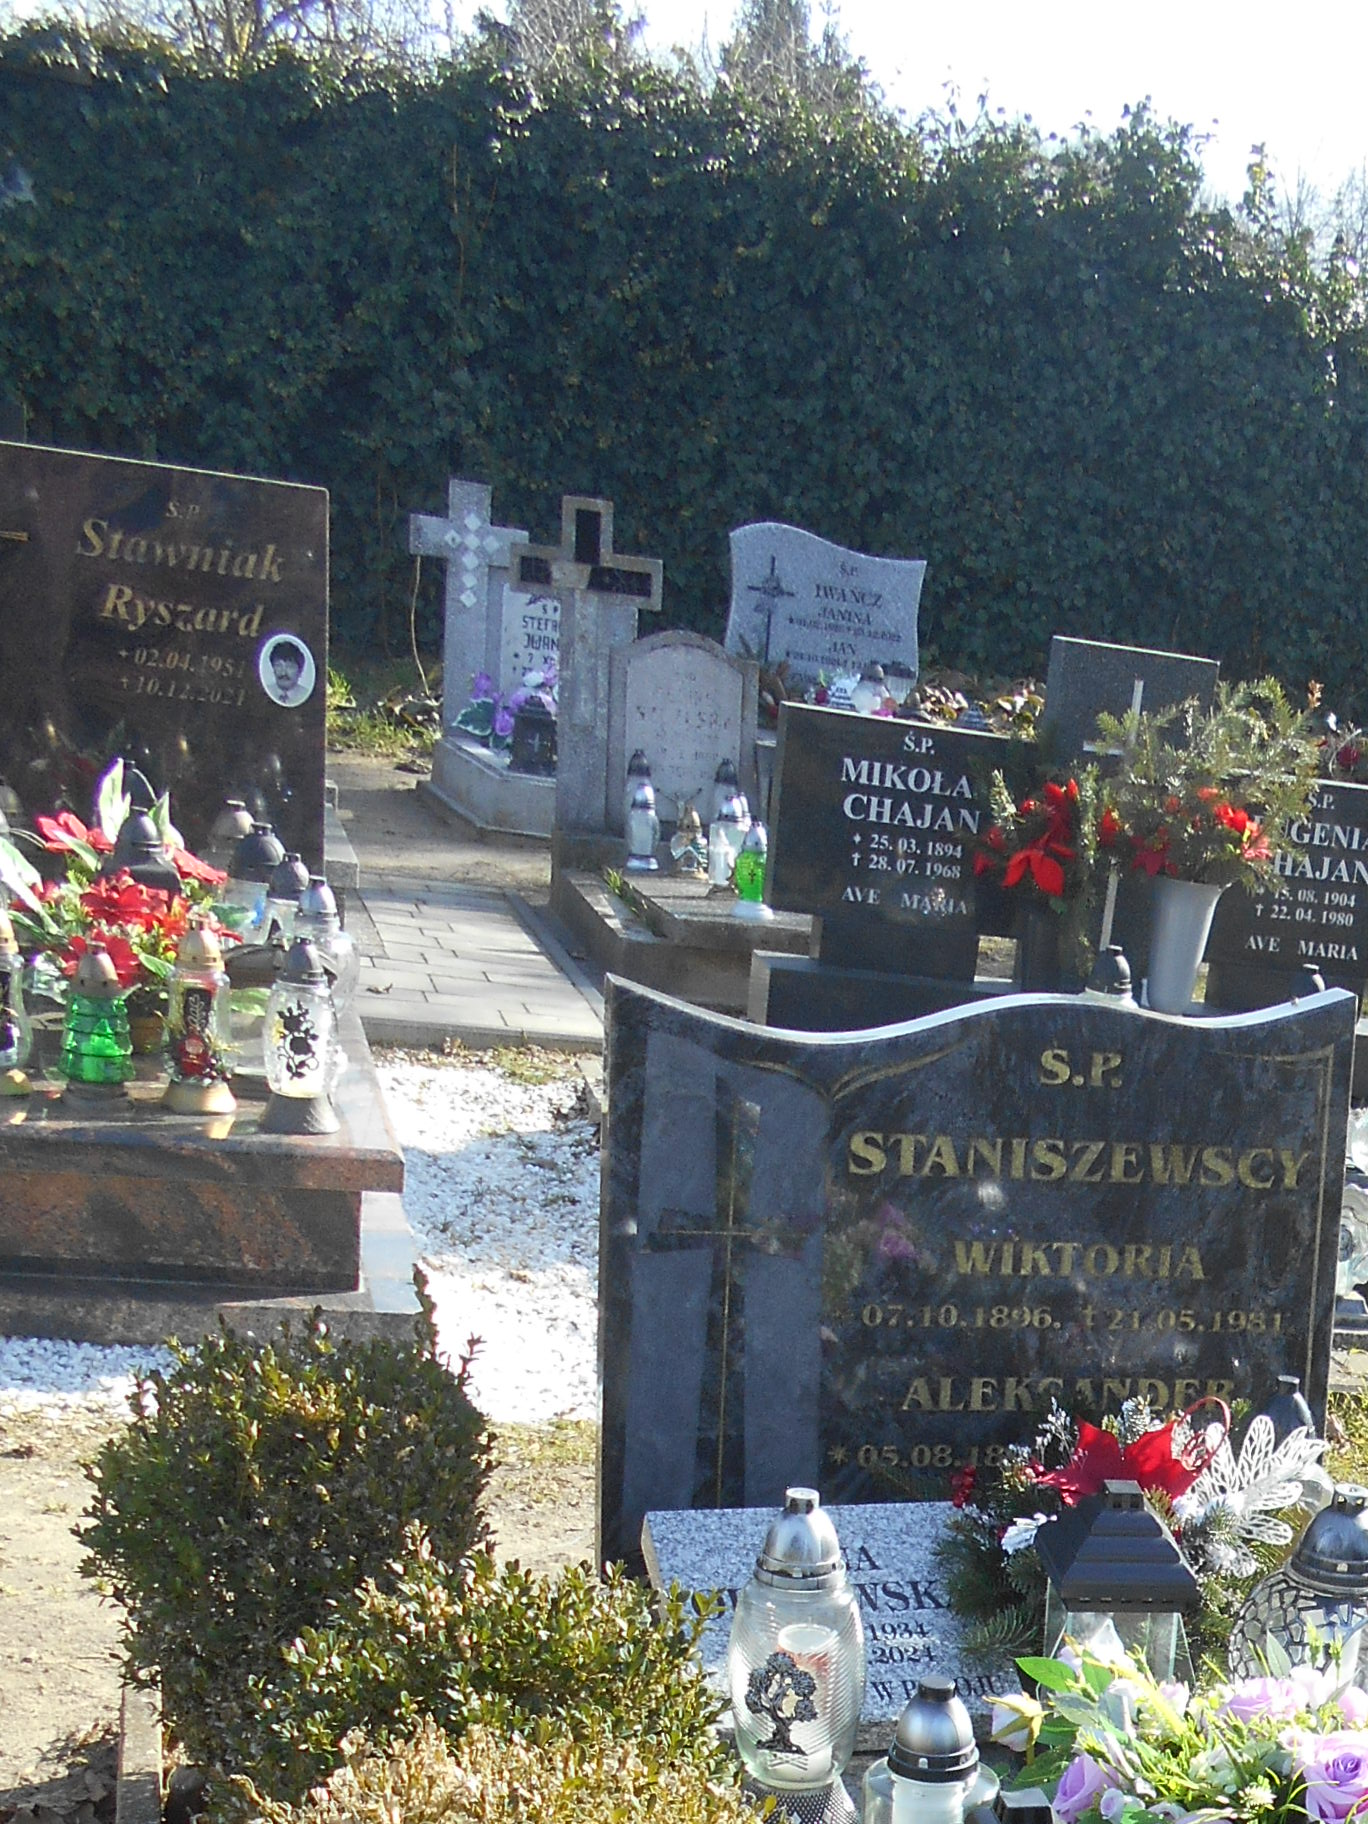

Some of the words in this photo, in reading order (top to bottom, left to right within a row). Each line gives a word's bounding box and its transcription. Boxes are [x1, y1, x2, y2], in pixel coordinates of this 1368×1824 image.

[77, 518, 285, 583] Stawniak
[100, 584, 264, 637] Ryszard
[818, 606, 872, 625] JANINA
[522, 615, 559, 632] STEFA
[828, 642, 857, 655] JAN
[903, 731, 935, 754] Ś.P.
[841, 757, 973, 799] MIKOŁA
[843, 793, 981, 835] CHAJAN
[927, 841, 963, 859] 1894
[925, 862, 961, 879] 1968
[841, 886, 881, 905] AVE
[900, 892, 968, 915] MARIA
[1323, 891, 1356, 908] 1904
[1321, 910, 1354, 927] 1980
[1245, 935, 1280, 952] AVE
[1298, 940, 1358, 960] MARIA
[847, 1130, 1312, 1190] STANISZEWSCY
[953, 1240, 1206, 1281] WIKTORIA
[857, 1443, 1003, 1470] 05.08.18
